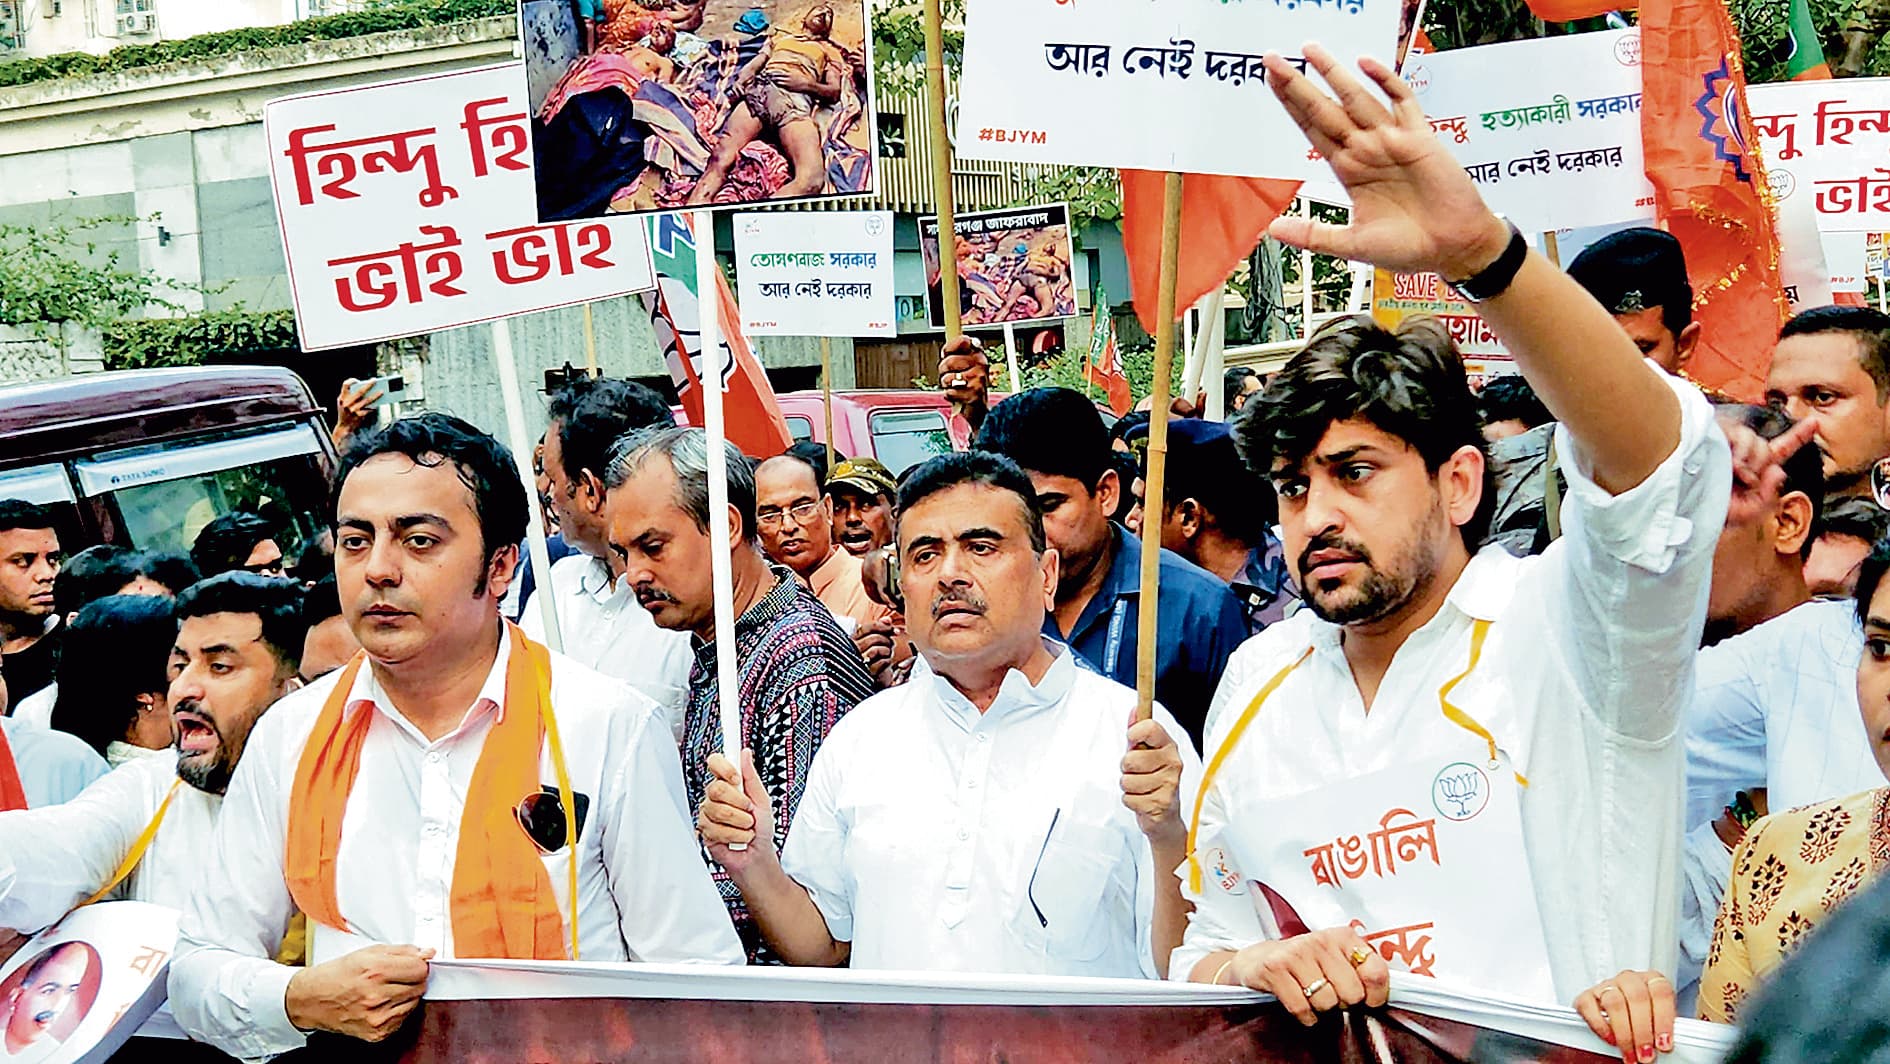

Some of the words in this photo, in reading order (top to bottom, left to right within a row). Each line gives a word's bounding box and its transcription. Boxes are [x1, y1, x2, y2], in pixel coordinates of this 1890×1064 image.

[1045, 44, 1112, 78] আর
[1123, 37, 1194, 79] নেই
[1480, 94, 1572, 131] হত্যাকারী
[978, 128, 1047, 144] #BJYM
[284, 123, 459, 208] হিন্দু
[1507, 149, 1551, 178] নেই
[1556, 145, 1623, 173] দরকার
[327, 224, 468, 313] ভাই
[829, 252, 877, 269] সরকার
[758, 283, 790, 299] আর
[794, 278, 822, 299] নেই
[826, 283, 872, 299] দরকার
[1394, 272, 1438, 298] SAVE
[1303, 808, 1440, 889] বাঙালি
